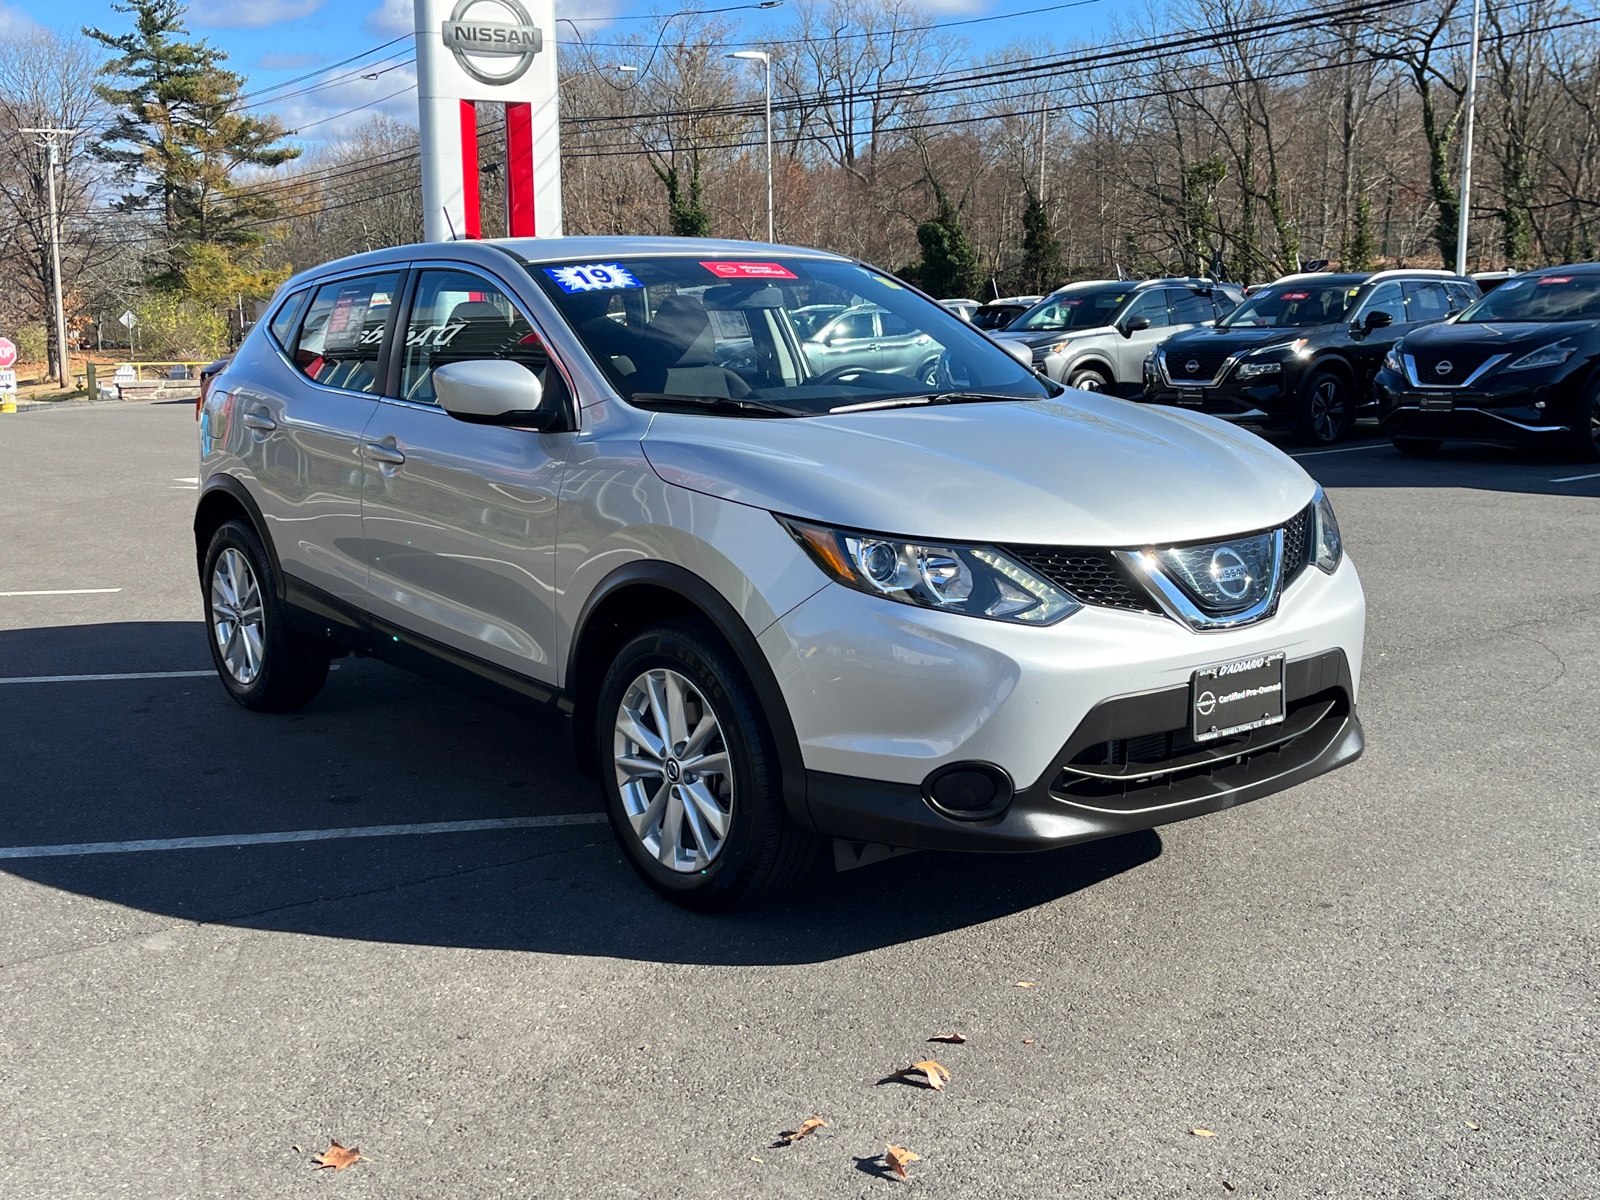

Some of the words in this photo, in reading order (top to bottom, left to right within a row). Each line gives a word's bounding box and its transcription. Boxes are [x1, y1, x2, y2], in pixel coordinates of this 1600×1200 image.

[454, 26, 535, 45] NISSAN
[573, 268, 613, 285] 19
[0, 346, 13, 358] OP
[0, 373, 12, 382] XIT
[1215, 566, 1248, 580] NISSAN
[1219, 658, 1264, 676] D'ADDARIO
[1218, 690, 1245, 704] Certified
[1246, 682, 1282, 697] Pre-Owned
